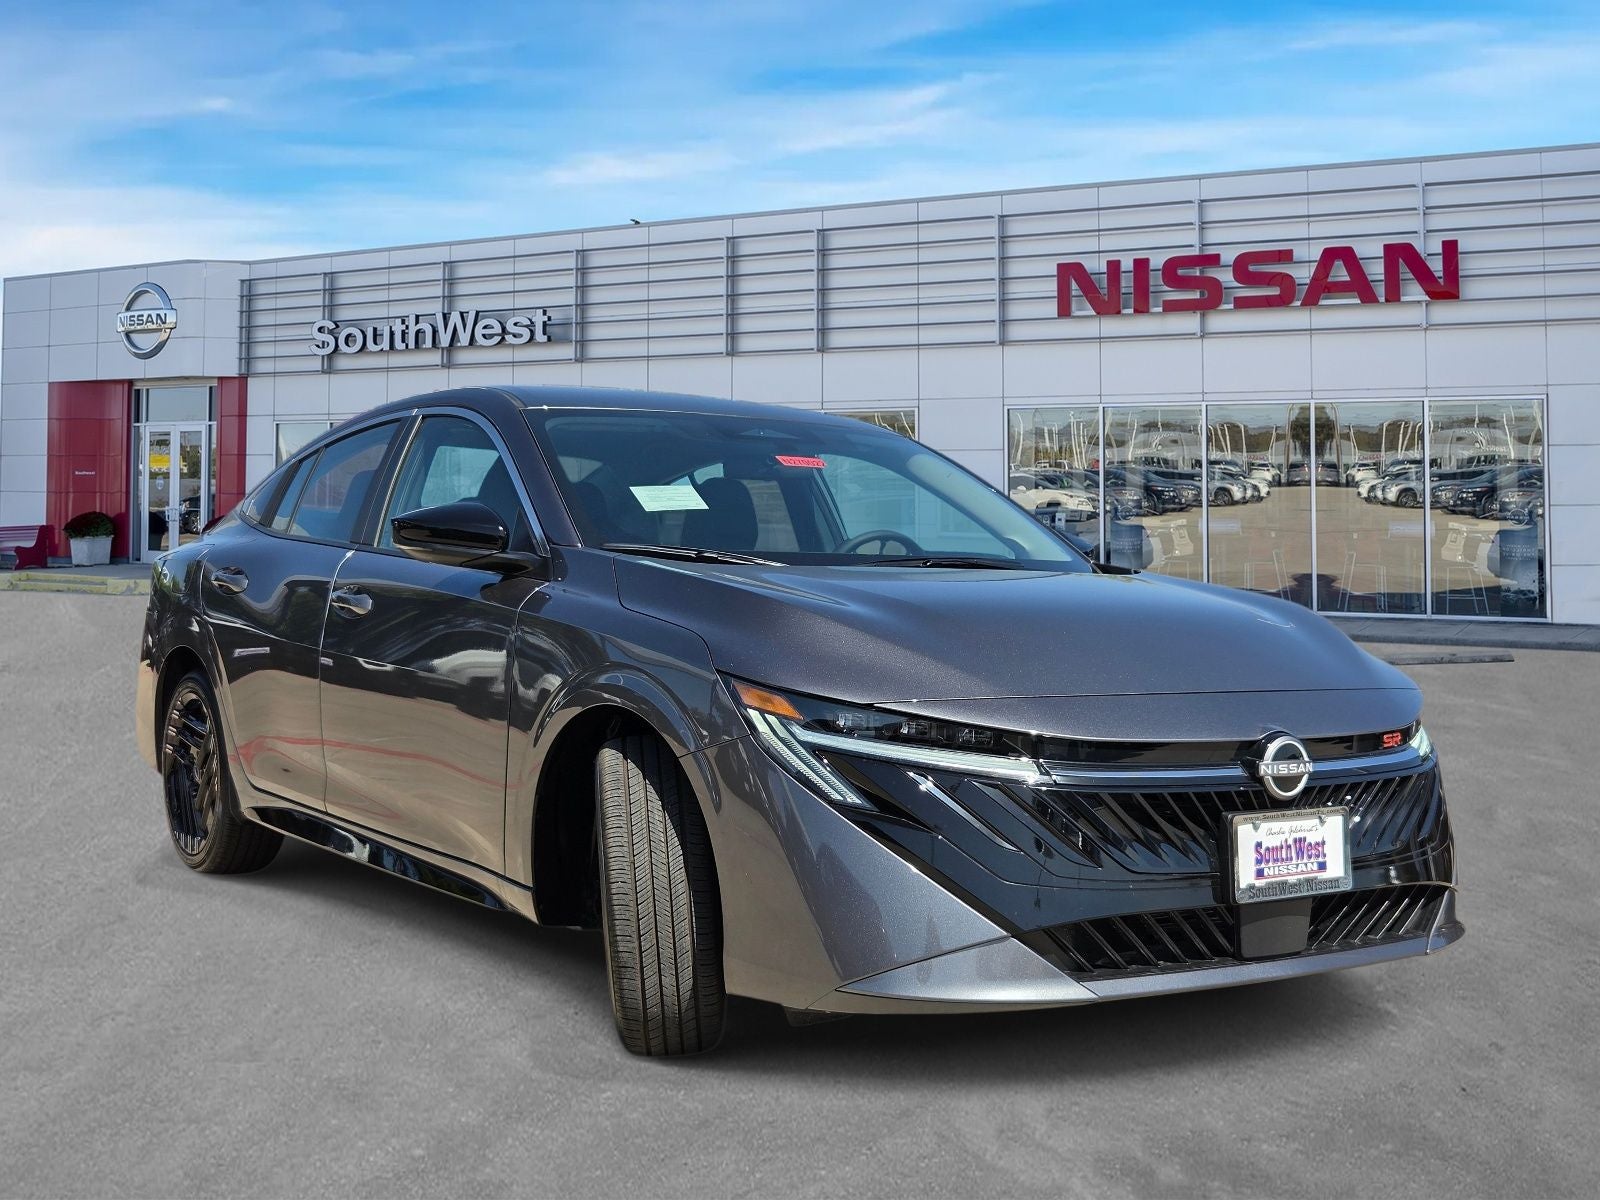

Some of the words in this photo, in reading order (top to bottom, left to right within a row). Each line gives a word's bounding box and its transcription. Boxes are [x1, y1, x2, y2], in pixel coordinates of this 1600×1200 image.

[1056, 239, 1460, 318] NISSAN
[119, 312, 167, 328] NISSAN
[310, 308, 551, 356] SouthWest
[1383, 732, 1401, 747] SR
[1260, 761, 1313, 775] NISSAN
[1254, 835, 1327, 866] SouthWest
[1263, 861, 1318, 877] NISSAN
[1248, 880, 1304, 900] SouthWest
[1306, 878, 1341, 893] Nissan
